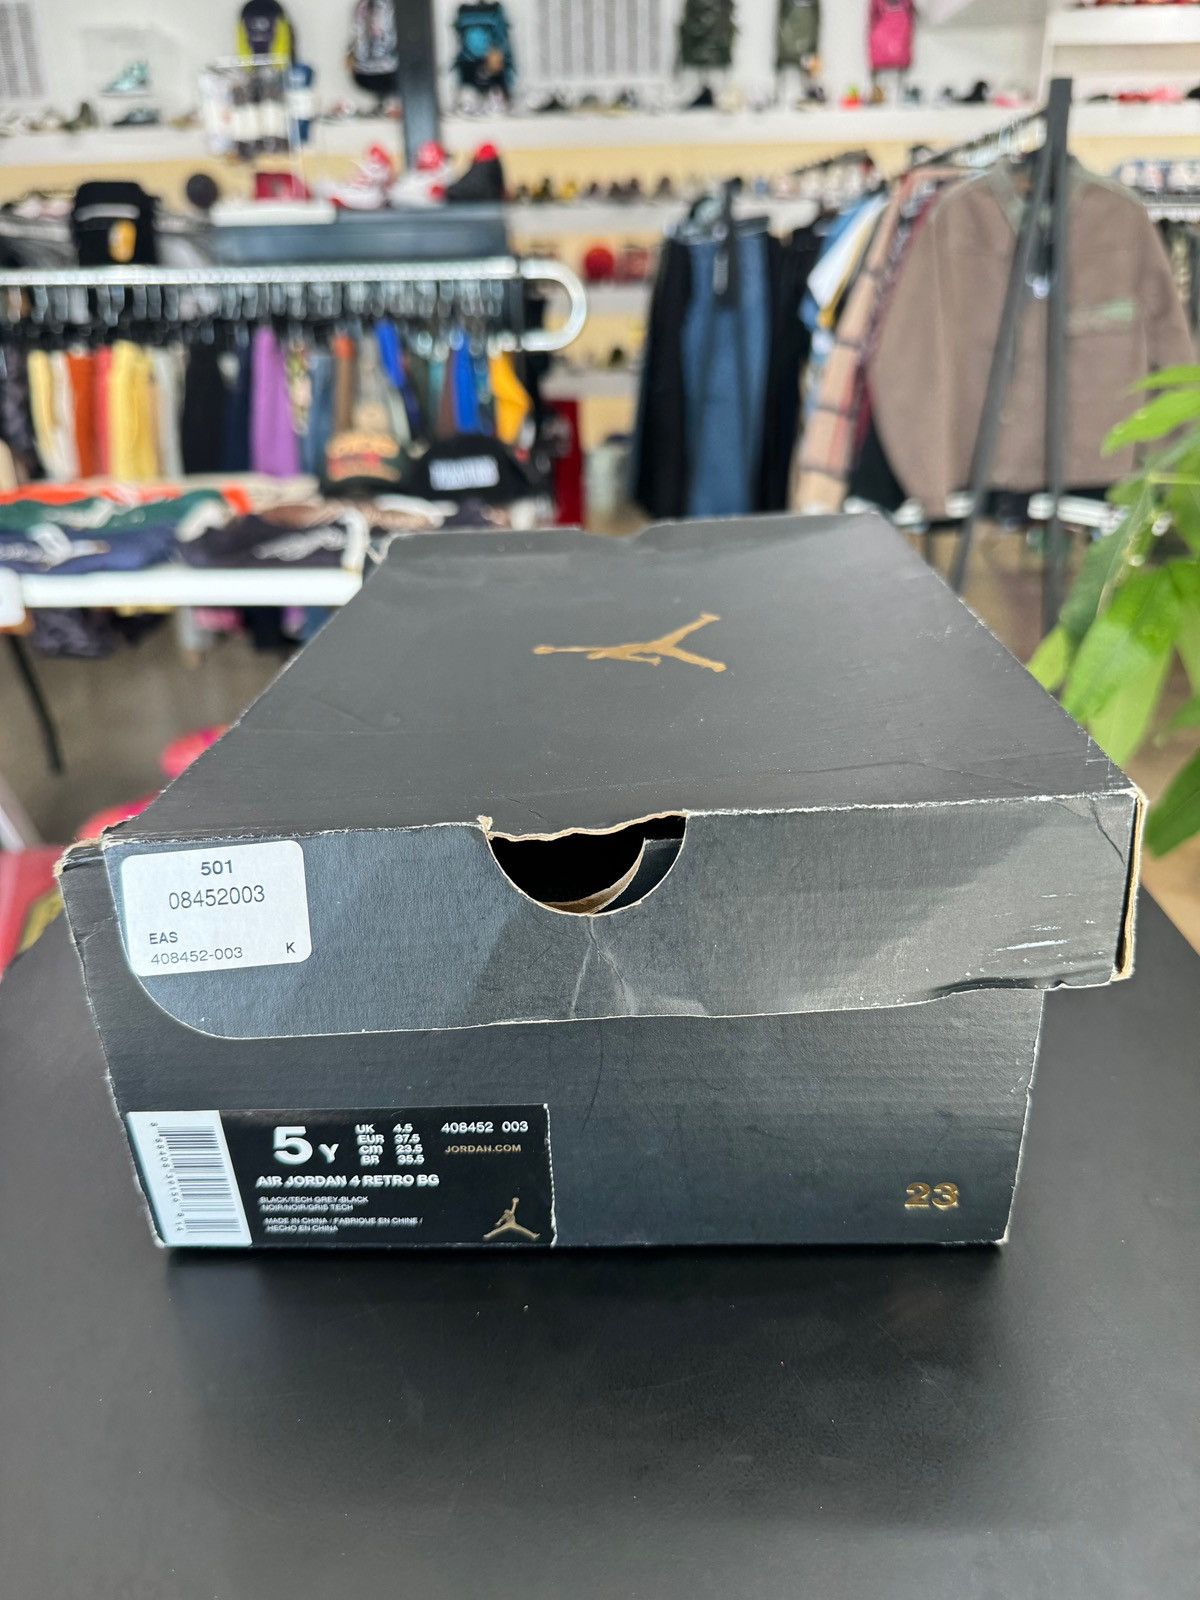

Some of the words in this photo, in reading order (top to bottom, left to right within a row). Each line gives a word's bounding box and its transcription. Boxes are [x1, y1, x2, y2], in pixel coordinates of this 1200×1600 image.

[200, 859, 234, 876] 501
[168, 884, 266, 910] 08452003
[149, 931, 178, 945] EAS
[286, 941, 296, 954] K
[150, 946, 243, 966] 408452-003
[354, 1123, 376, 1135] UK
[440, 1121, 495, 1134] 408452
[501, 1120, 529, 1133] 003
[272, 1125, 314, 1166] 5
[317, 1143, 339, 1165] Y
[356, 1134, 385, 1146] EUR
[444, 1144, 522, 1154] JORDAN.COM
[360, 1154, 380, 1167] BR
[255, 1176, 283, 1189] AIR
[284, 1175, 348, 1188] JORDAN
[349, 1175, 361, 1188] 4
[362, 1174, 415, 1187] RETRO
[416, 1174, 440, 1187] BG
[904, 1182, 959, 1211] 23
